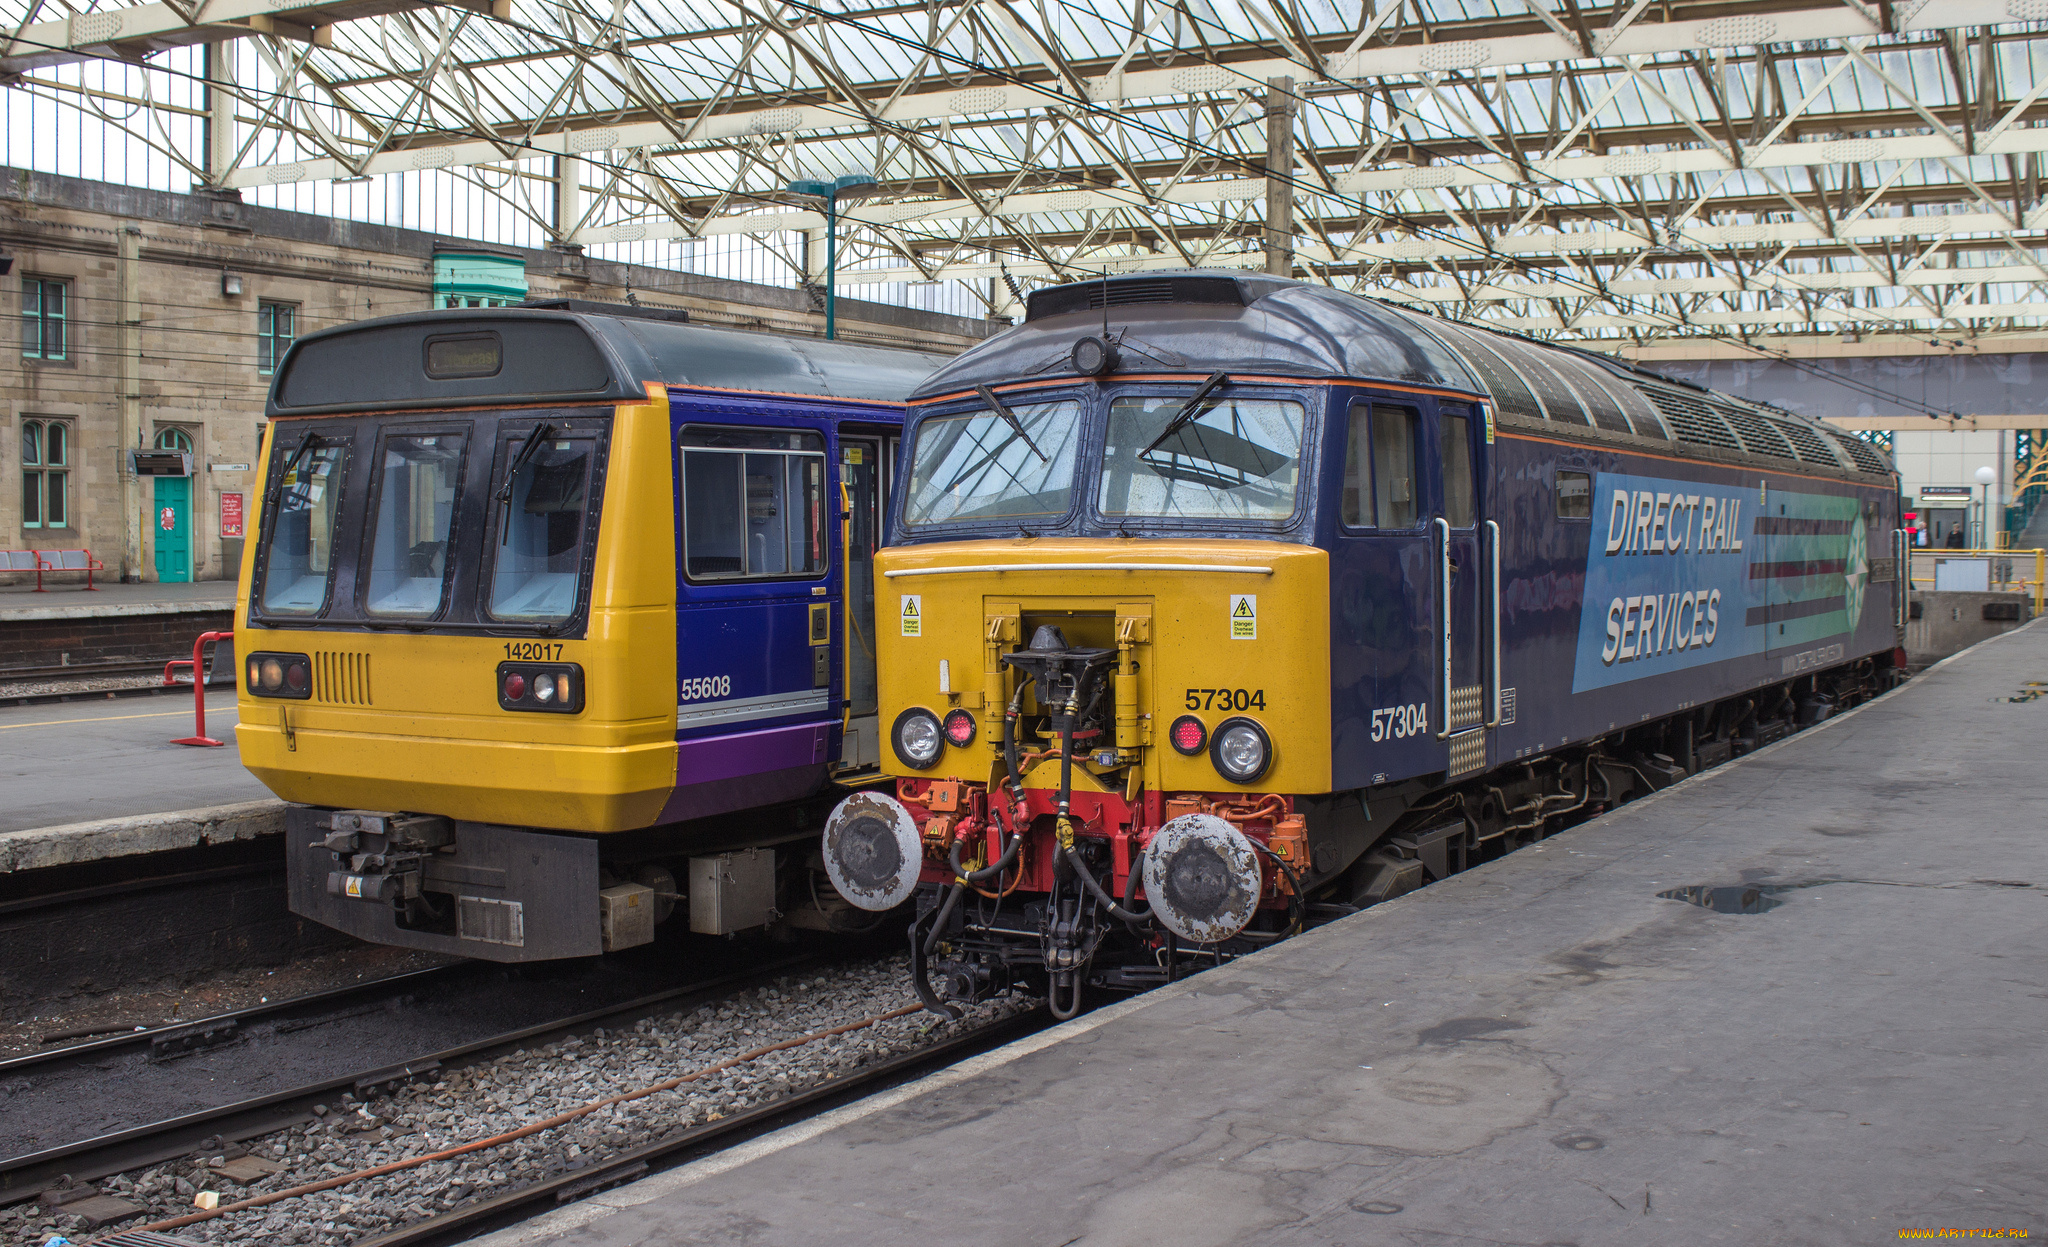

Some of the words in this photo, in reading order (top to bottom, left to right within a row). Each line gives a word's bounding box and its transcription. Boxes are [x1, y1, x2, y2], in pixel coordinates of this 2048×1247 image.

[1605, 489, 1700, 557] DIRECT
[1698, 496, 1743, 554] RAIL
[1601, 588, 1722, 667] SERVICES
[503, 642, 564, 661] 142017
[681, 675, 731, 700] 55608
[1185, 688, 1267, 711] 57304
[1370, 702, 1428, 742] 57304
